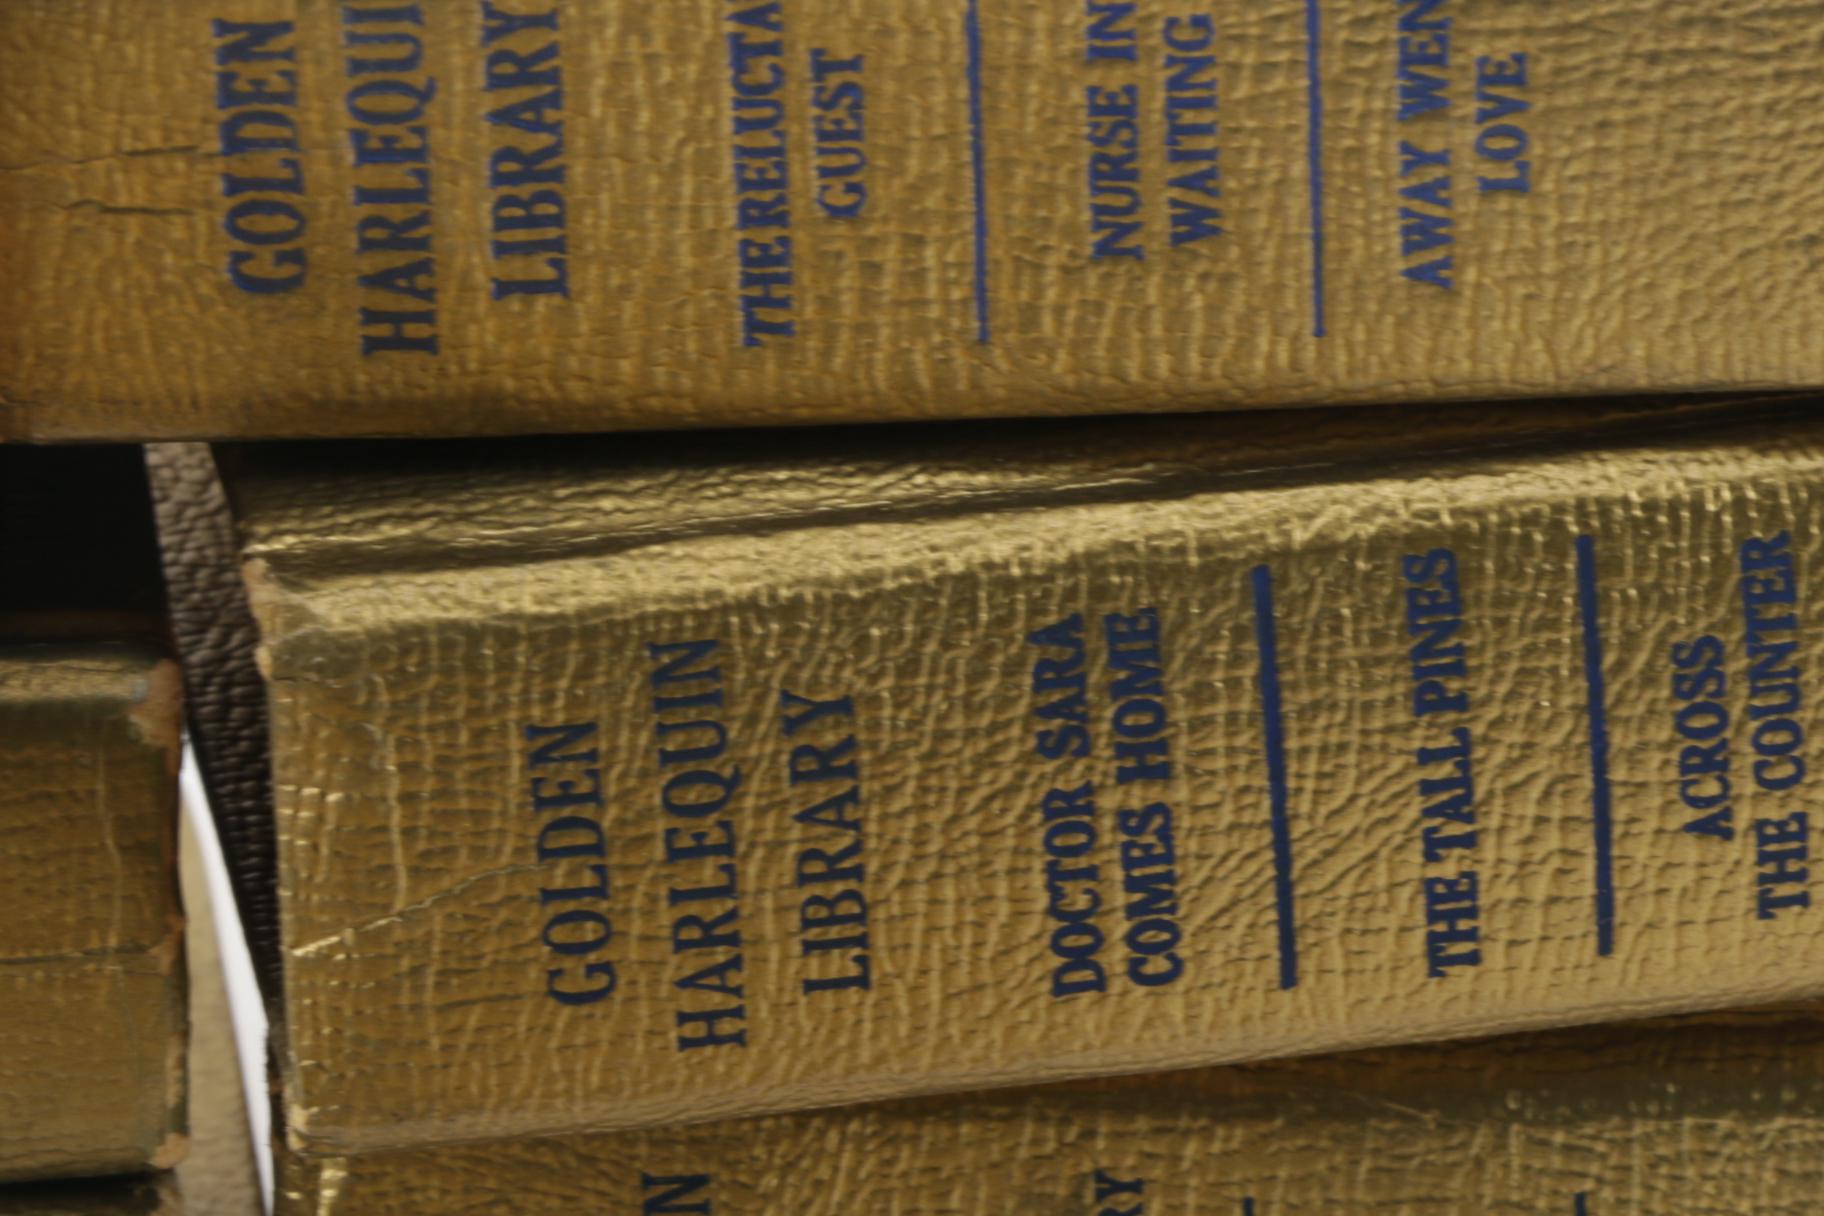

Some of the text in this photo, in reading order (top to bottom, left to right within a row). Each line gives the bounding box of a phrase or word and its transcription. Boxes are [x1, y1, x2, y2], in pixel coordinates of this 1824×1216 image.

[211, 18, 306, 295] GOLDEN
[479, 0, 570, 301] LIBRARY
[725, 0, 791, 231] RELUCTA
[809, 47, 868, 219] GUEST
[1083, 0, 1146, 262] NURSE IN
[1162, 13, 1224, 248] WAITING
[1397, 140, 1457, 290] AWAY
[1473, 51, 1532, 194] LOVE
[523, 722, 617, 1006] GOLDEN
[645, 638, 747, 1050] HARLEQUIN
[778, 689, 871, 994] LIBRARY
[1025, 612, 1107, 998] DOCTOR SARA
[1102, 606, 1185, 987] COMES HOME
[1399, 546, 1481, 978] THE TALL PINES
[1670, 634, 1735, 841] ACROSS
[1737, 529, 1811, 921] THE COUNTER
